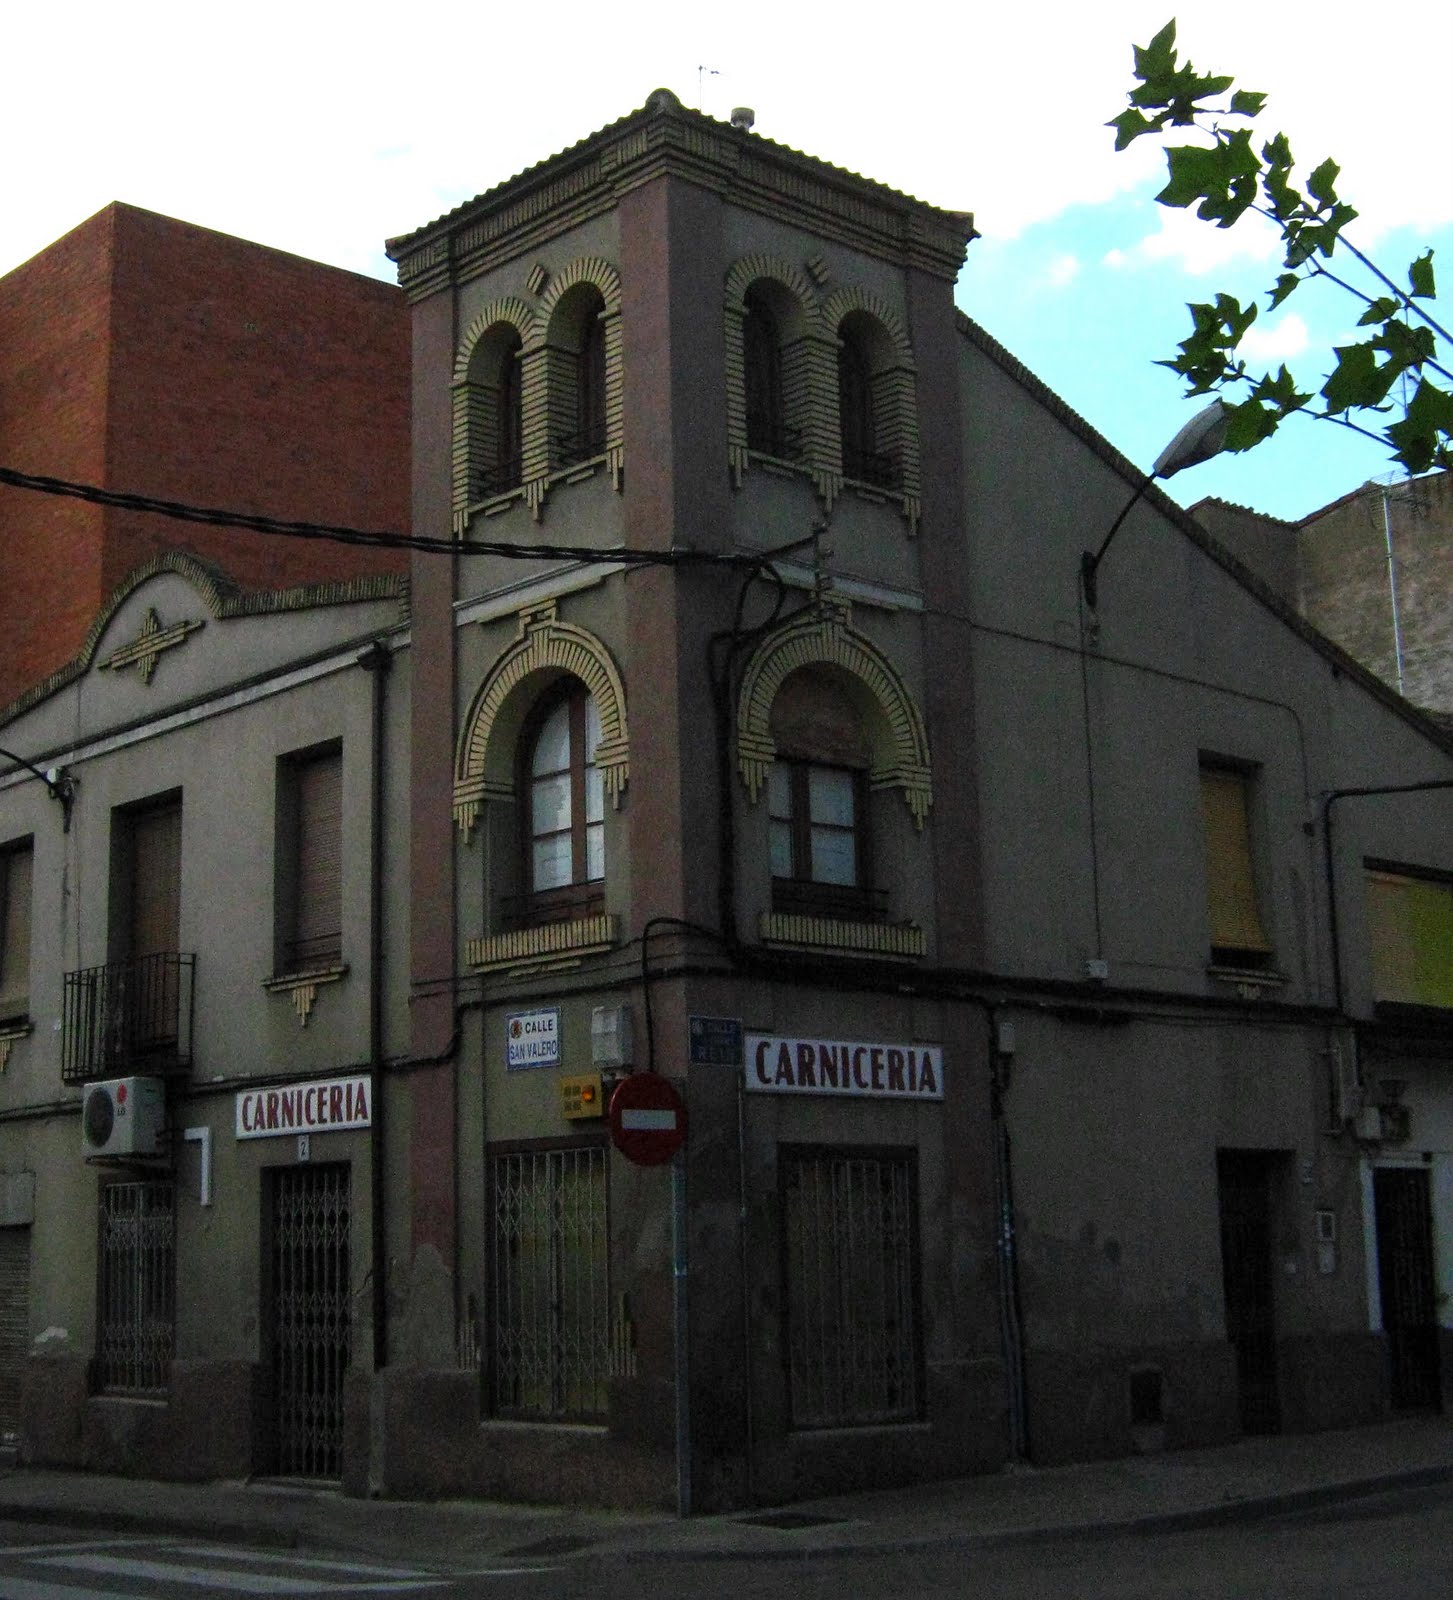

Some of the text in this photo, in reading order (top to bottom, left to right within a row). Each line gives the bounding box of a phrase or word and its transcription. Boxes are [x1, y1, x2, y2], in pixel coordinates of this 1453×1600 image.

[525, 1019, 553, 1033] CALLE
[510, 1040, 557, 1060] SAN VALERO
[756, 1041, 936, 1092] CARNICERIA
[242, 1083, 368, 1132] CARNICERIA
[300, 1142, 306, 1156] 2
